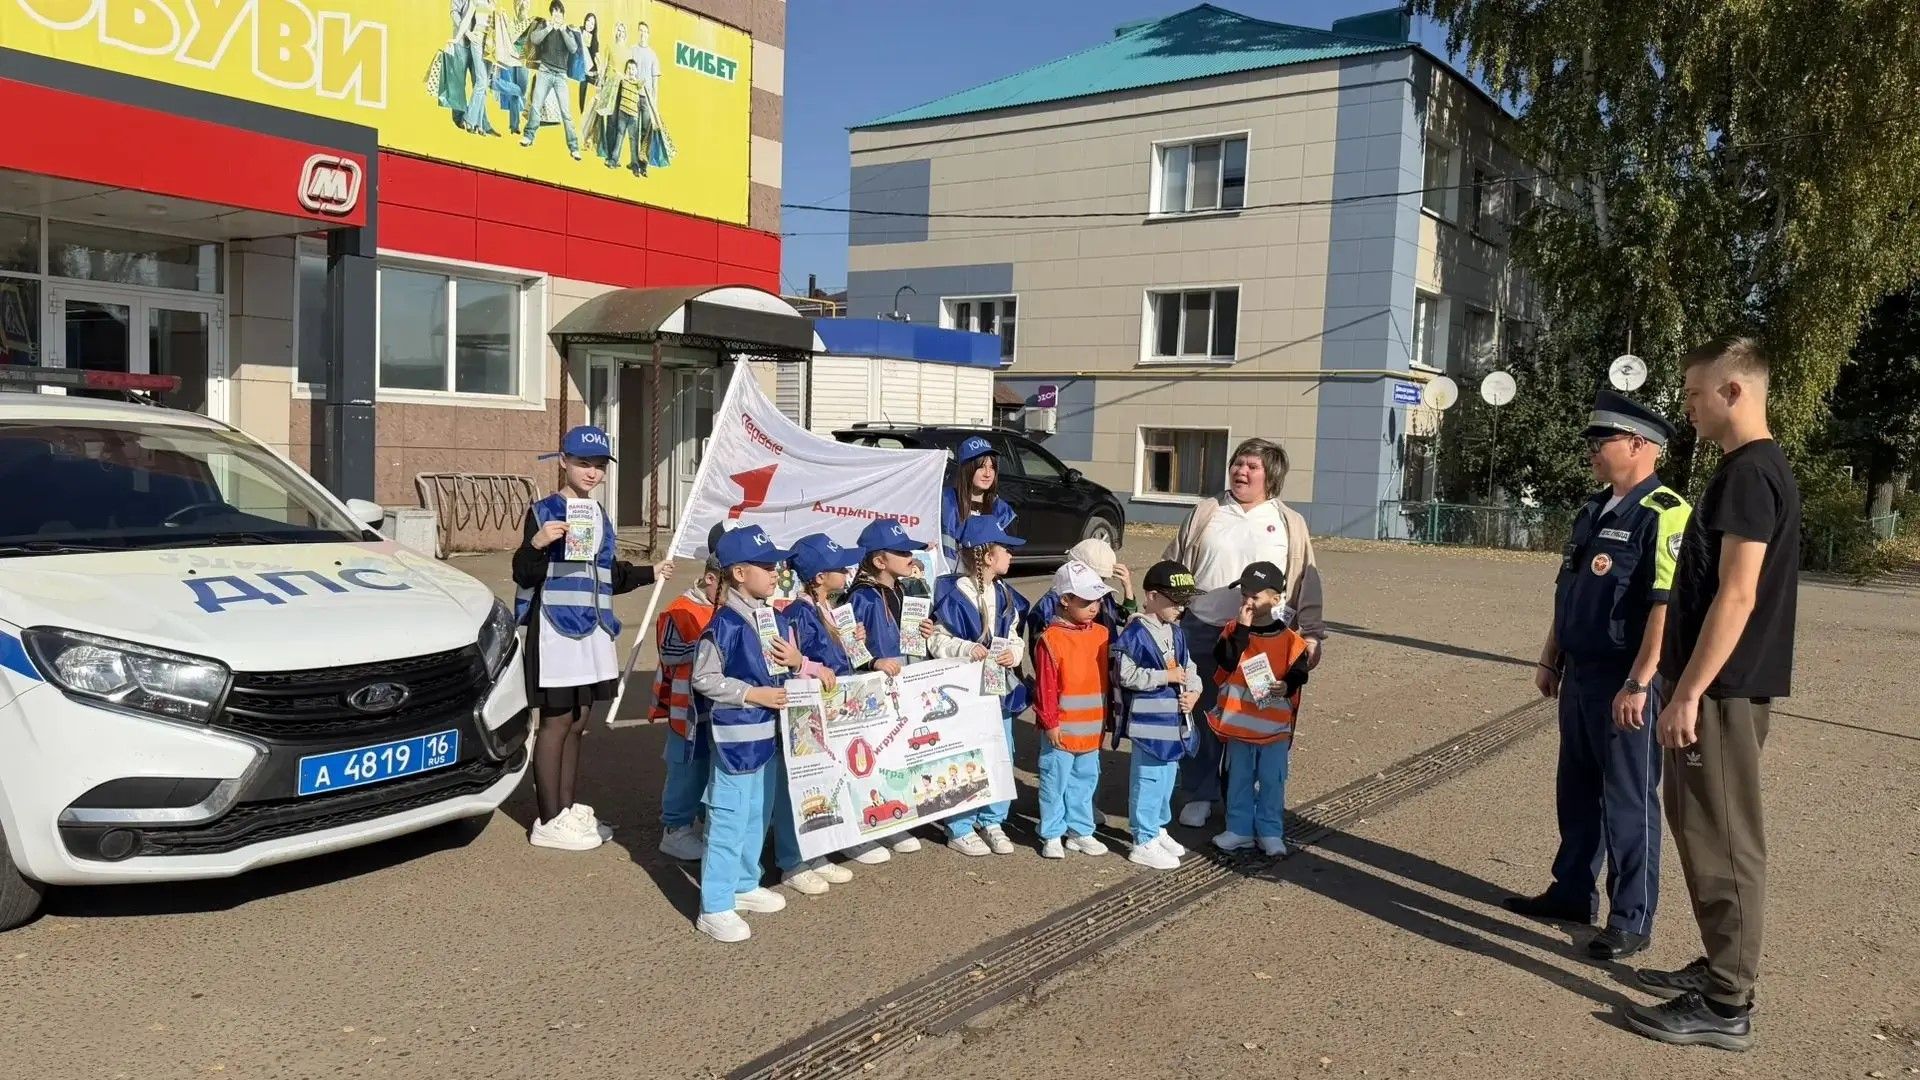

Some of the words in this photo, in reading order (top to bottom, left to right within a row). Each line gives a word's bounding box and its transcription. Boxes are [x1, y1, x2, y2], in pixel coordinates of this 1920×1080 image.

[676, 42, 738, 80] КИБЕТ
[582, 433, 608, 449] ЮИД
[741, 412, 783, 456] Первые
[812, 501, 920, 528] Алдынгылар
[181, 568, 413, 614] ДПС
[427, 735, 449, 757] 16
[874, 715, 909, 755] игрушка
[315, 765, 331, 787] А
[344, 745, 410, 781] 4819
[428, 754, 446, 766] RUS
[879, 767, 905, 779] игра
